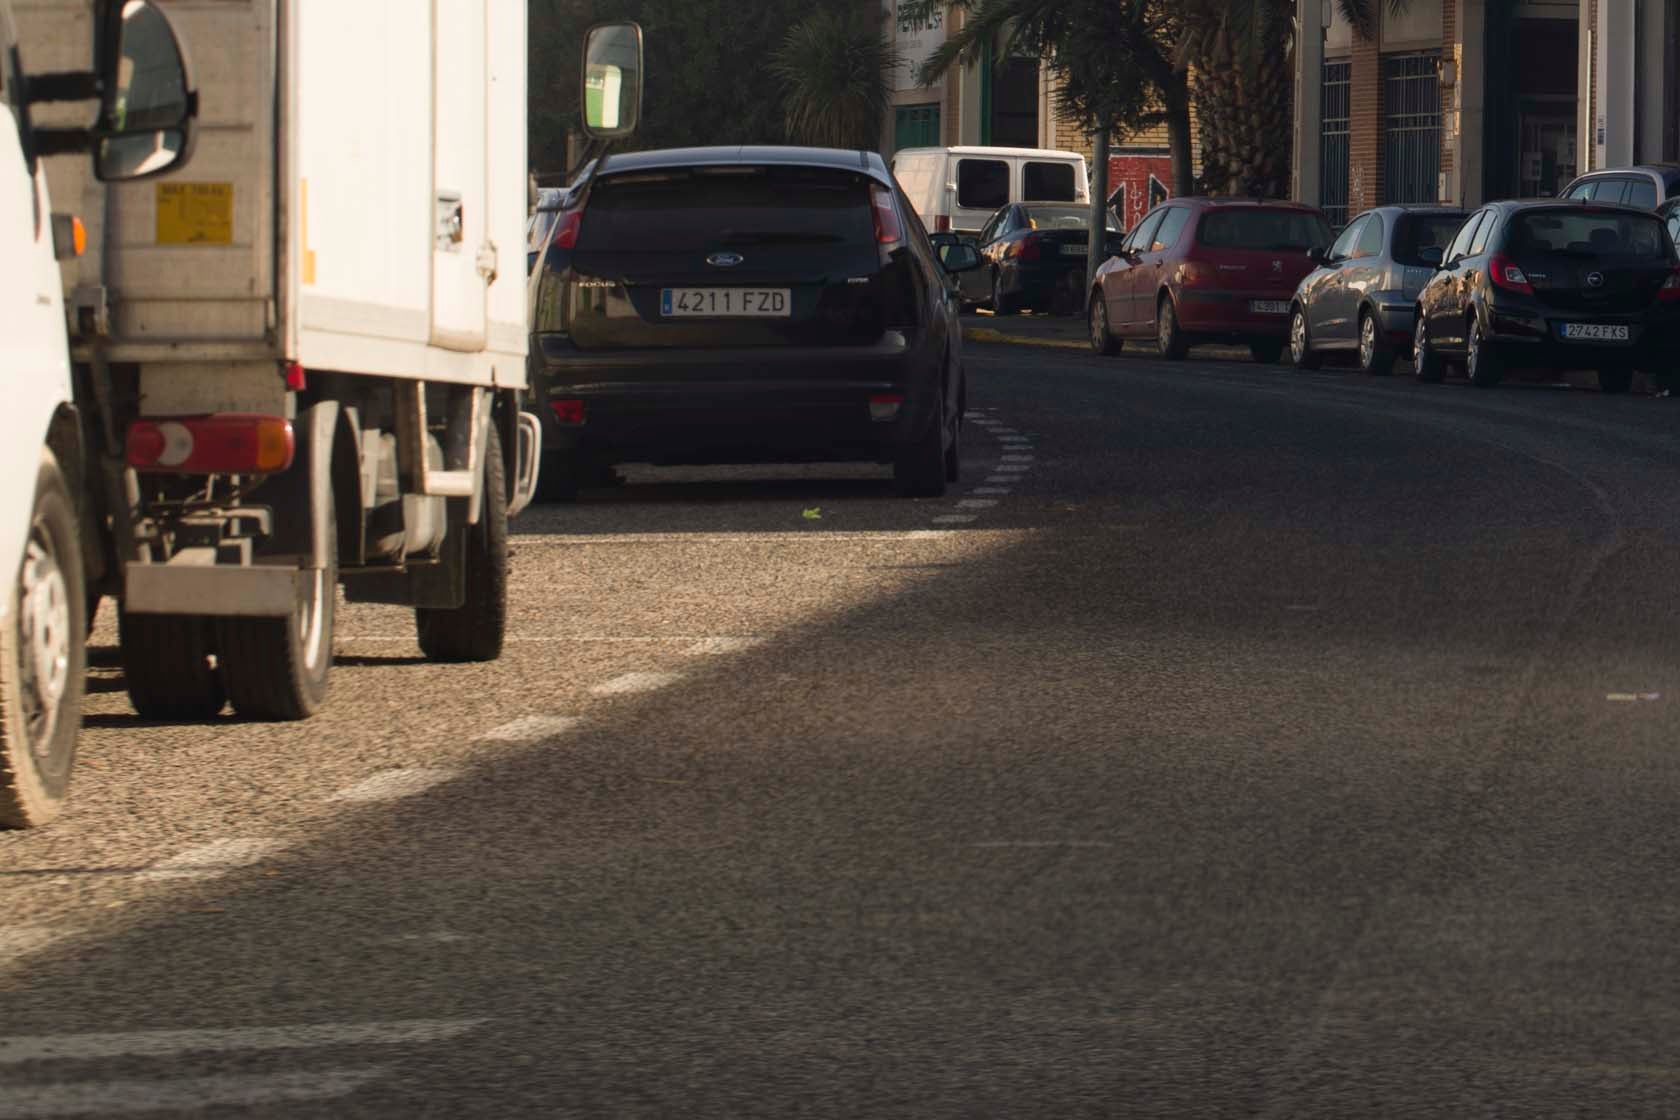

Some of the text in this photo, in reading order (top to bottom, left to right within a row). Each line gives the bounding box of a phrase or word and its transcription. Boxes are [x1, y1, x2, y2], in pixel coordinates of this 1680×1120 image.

[678, 291, 785, 312] 4211 FZD
[1568, 325, 1626, 338] 2742 FXS
